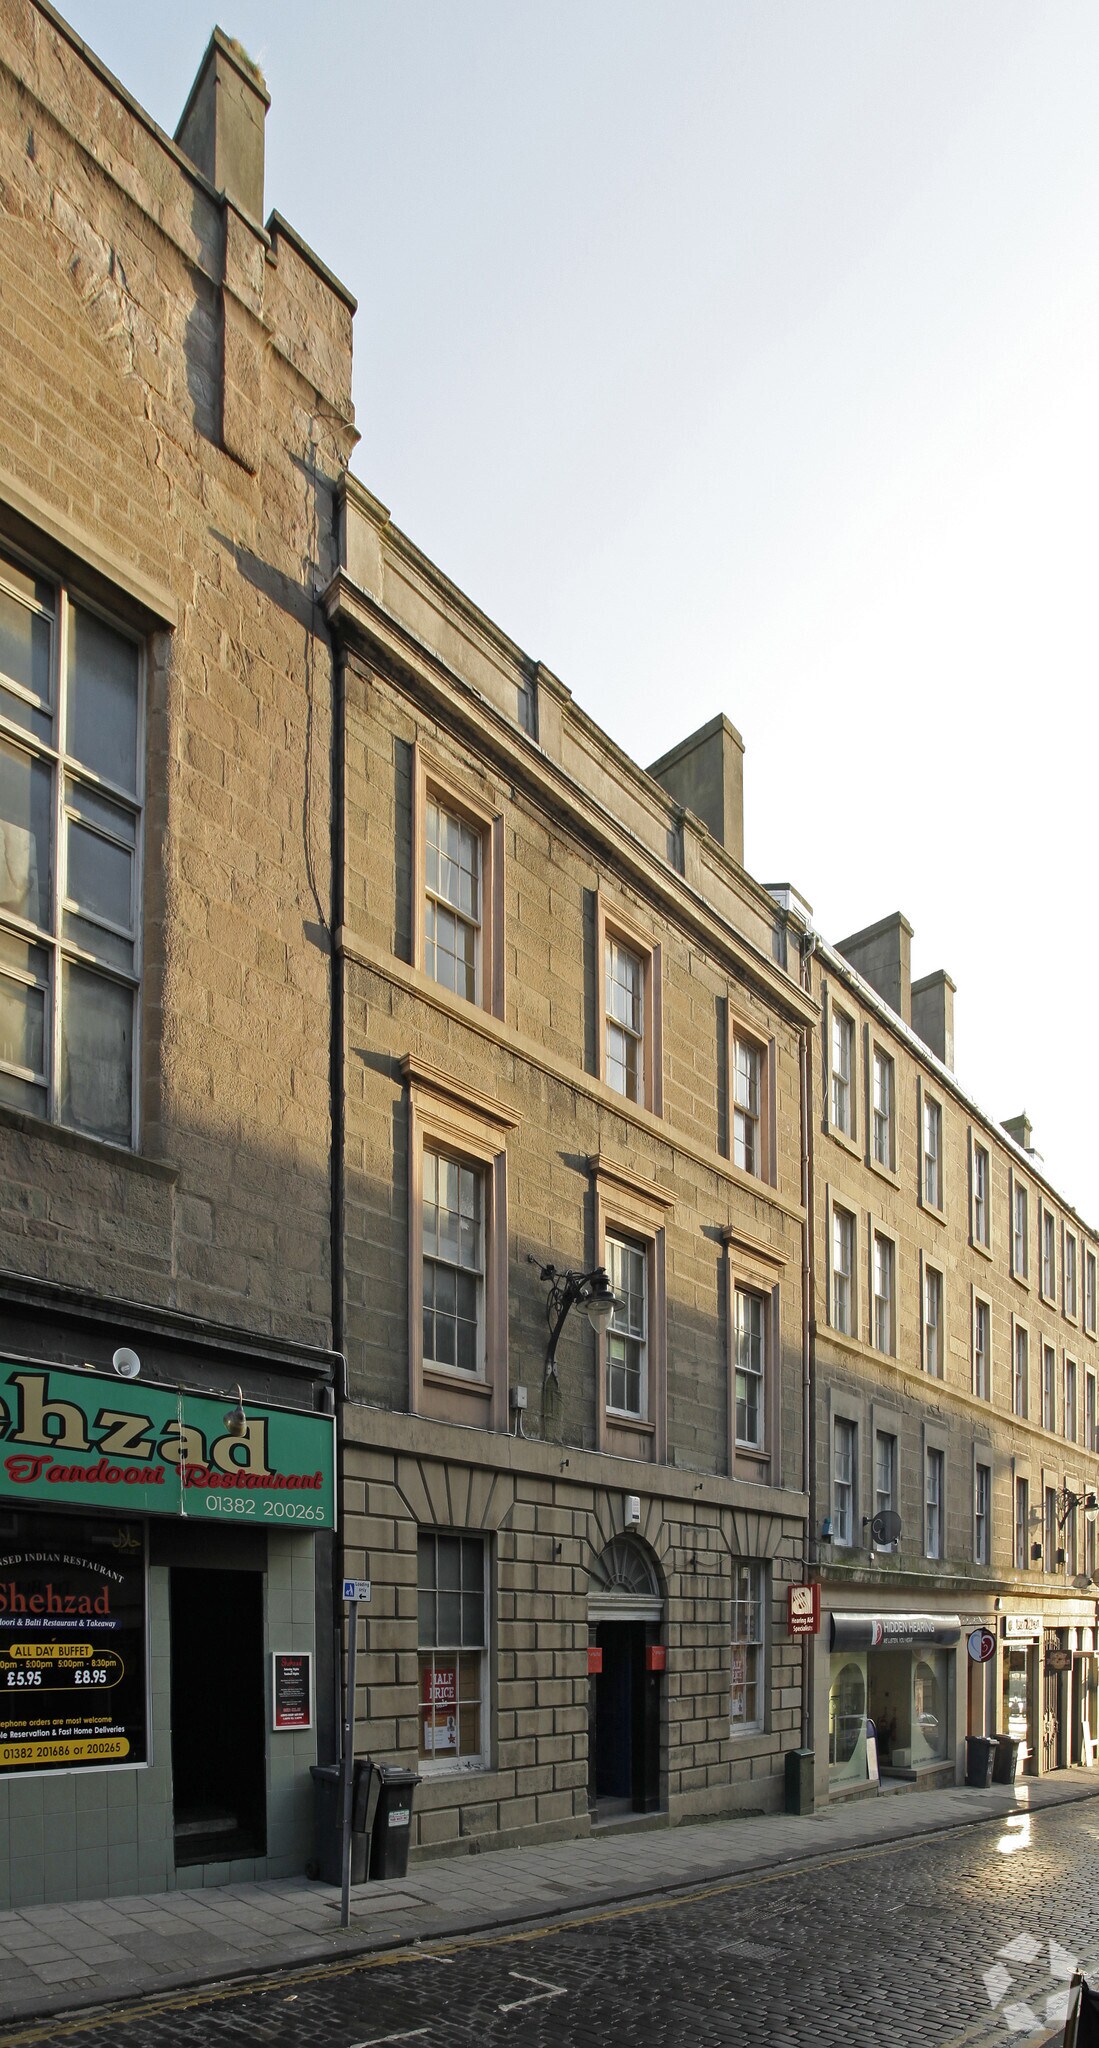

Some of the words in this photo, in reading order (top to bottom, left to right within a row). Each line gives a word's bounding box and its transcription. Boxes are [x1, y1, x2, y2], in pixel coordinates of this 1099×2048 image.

[0, 1371, 277, 1476] hzad
[4, 1454, 166, 1486] Tandoori
[176, 1463, 324, 1490] Restaurant
[206, 1495, 256, 1515] 01382
[264, 1501, 325, 1521] 200265
[25, 1553, 60, 1562] INDIAN
[63, 1554, 125, 1584] RESTAURANT
[17, 1618, 23, 1626] &
[25, 1618, 41, 1627] Balti
[43, 1619, 77, 1627] Restaurant
[79, 1619, 84, 1627] &
[86, 1619, 116, 1628] Takeaway
[792, 1617, 806, 1625] Hearing
[884, 1621, 908, 1633] HIDDEN
[909, 1621, 935, 1633] HEARING
[15, 1646, 31, 1657] ALL
[36, 1646, 54, 1656] DAY
[58, 1646, 89, 1656] BUFFET
[26, 1660, 53, 1669] 5:00pm
[58, 1660, 84, 1669] 5:00pm
[91, 1659, 117, 1668] 8:30pm
[7, 1671, 42, 1686] £5.95
[75, 1670, 107, 1684] £8.95
[29, 1718, 51, 1727] orders
[65, 1717, 82, 1725] most
[83, 1716, 113, 1724] welcome
[10, 1729, 50, 1738] Reservation
[58, 1728, 72, 1736] Fast
[73, 1727, 93, 1735] Home
[94, 1725, 125, 1734] Deliveries
[4, 1748, 33, 1759] 01382
[37, 1746, 70, 1757] 201686
[74, 1746, 84, 1754] or
[87, 1742, 121, 1754] 200265
